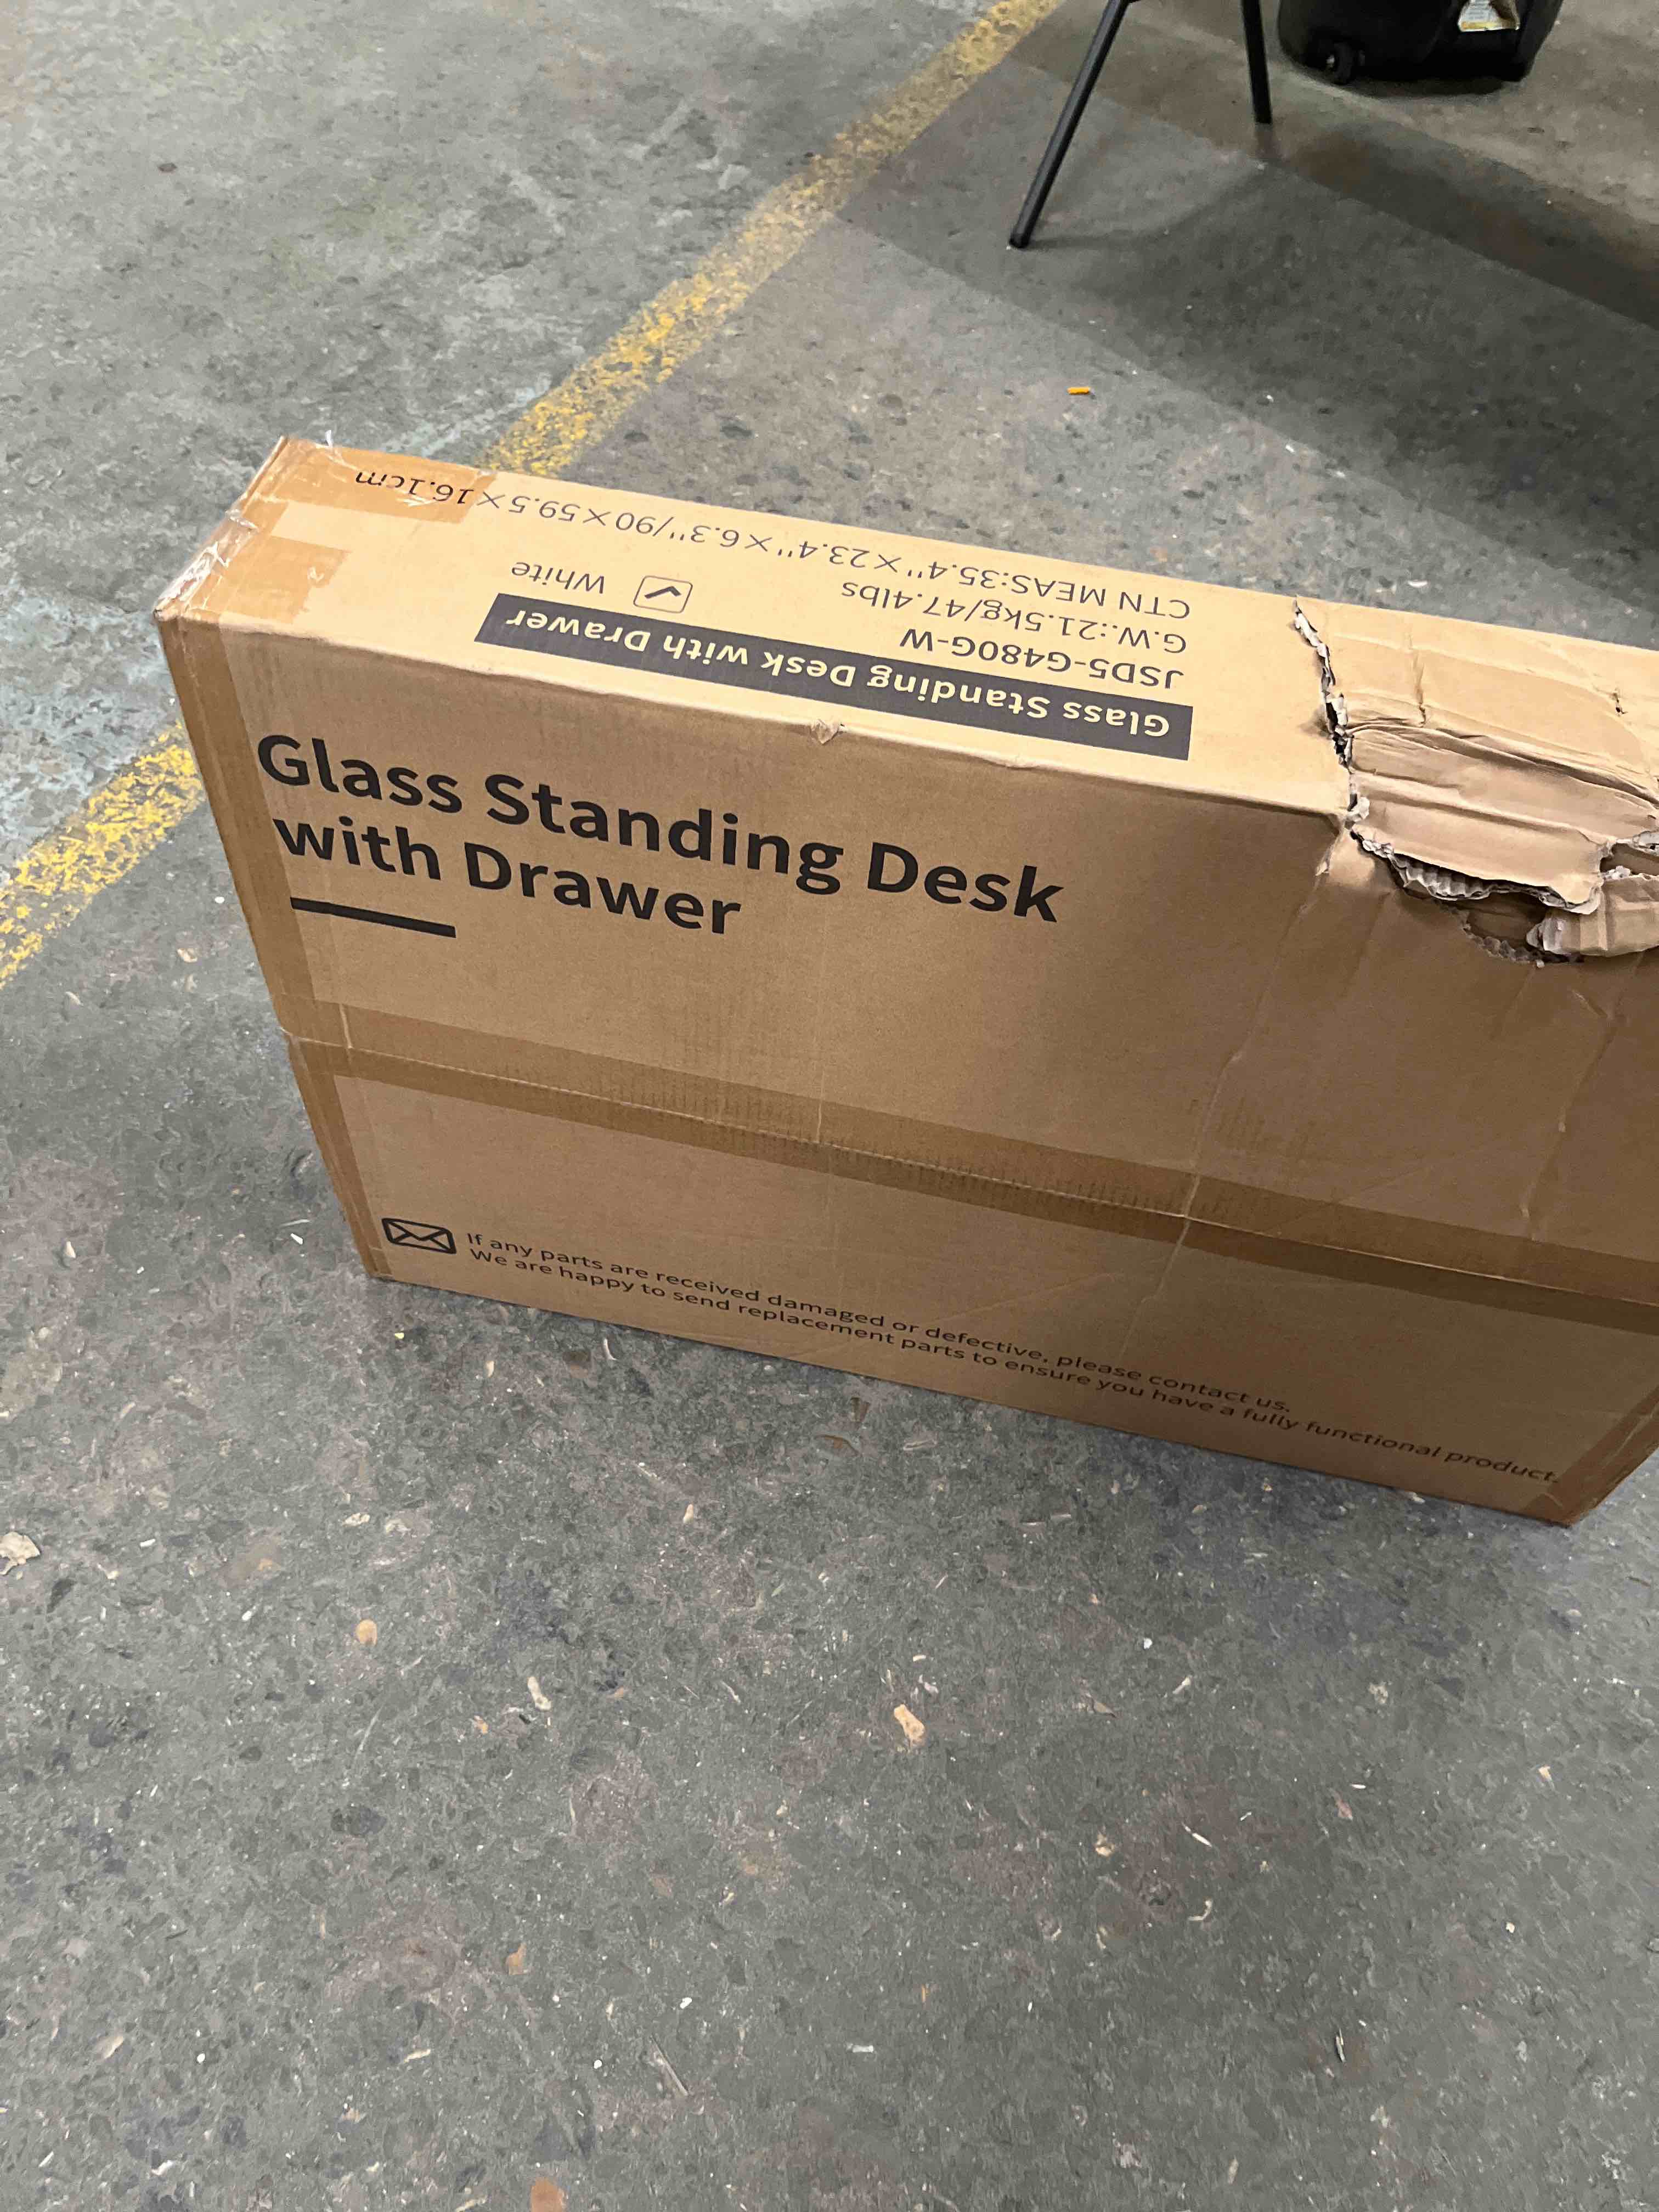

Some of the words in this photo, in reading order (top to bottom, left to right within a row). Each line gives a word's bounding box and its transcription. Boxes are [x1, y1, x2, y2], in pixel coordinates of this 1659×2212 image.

[511, 560, 605, 595] White
[1119, 591, 1190, 619] CTN
[505, 610, 651, 652] Drawer
[663, 635, 748, 665] with
[760, 651, 856, 687] Desk
[899, 628, 1184, 690] JSD5-G480G-W
[866, 664, 1049, 718] Standing
[1063, 702, 1170, 737] Glass
[258, 735, 462, 814] Glass
[484, 774, 844, 895] Standing
[867, 842, 1064, 923] Desk
[272, 818, 441, 881] with
[464, 842, 742, 935] Drawer
[467, 1233, 483, 1245] If
[490, 1240, 533, 1257] any
[540, 1250, 603, 1269] parts
[610, 1263, 648, 1279] are
[656, 1273, 759, 1302] received
[768, 1295, 884, 1327] damaged
[892, 1322, 919, 1333] or
[926, 1327, 1048, 1363] defective,
[1056, 1356, 1142, 1380] please
[1148, 1376, 1249, 1403] contact
[1256, 1398, 1290, 1413] us.
[470, 1248, 507, 1266] We
[515, 1260, 552, 1274] are
[559, 1266, 634, 1293] happy
[640, 1283, 665, 1297] to
[673, 1292, 730, 1311] send
[738, 1305, 894, 1345] replacement
[901, 1339, 964, 1359] parts
[973, 1352, 997, 1365] to
[1005, 1361, 1091, 1385] ensure
[1097, 1379, 1144, 1396] you
[1152, 1389, 1214, 1411] have
[1220, 1407, 1235, 1416] a
[1243, 1408, 1299, 1430] fully
[1306, 1421, 1442, 1457] functional
[1443, 1452, 1559, 1483] product.
